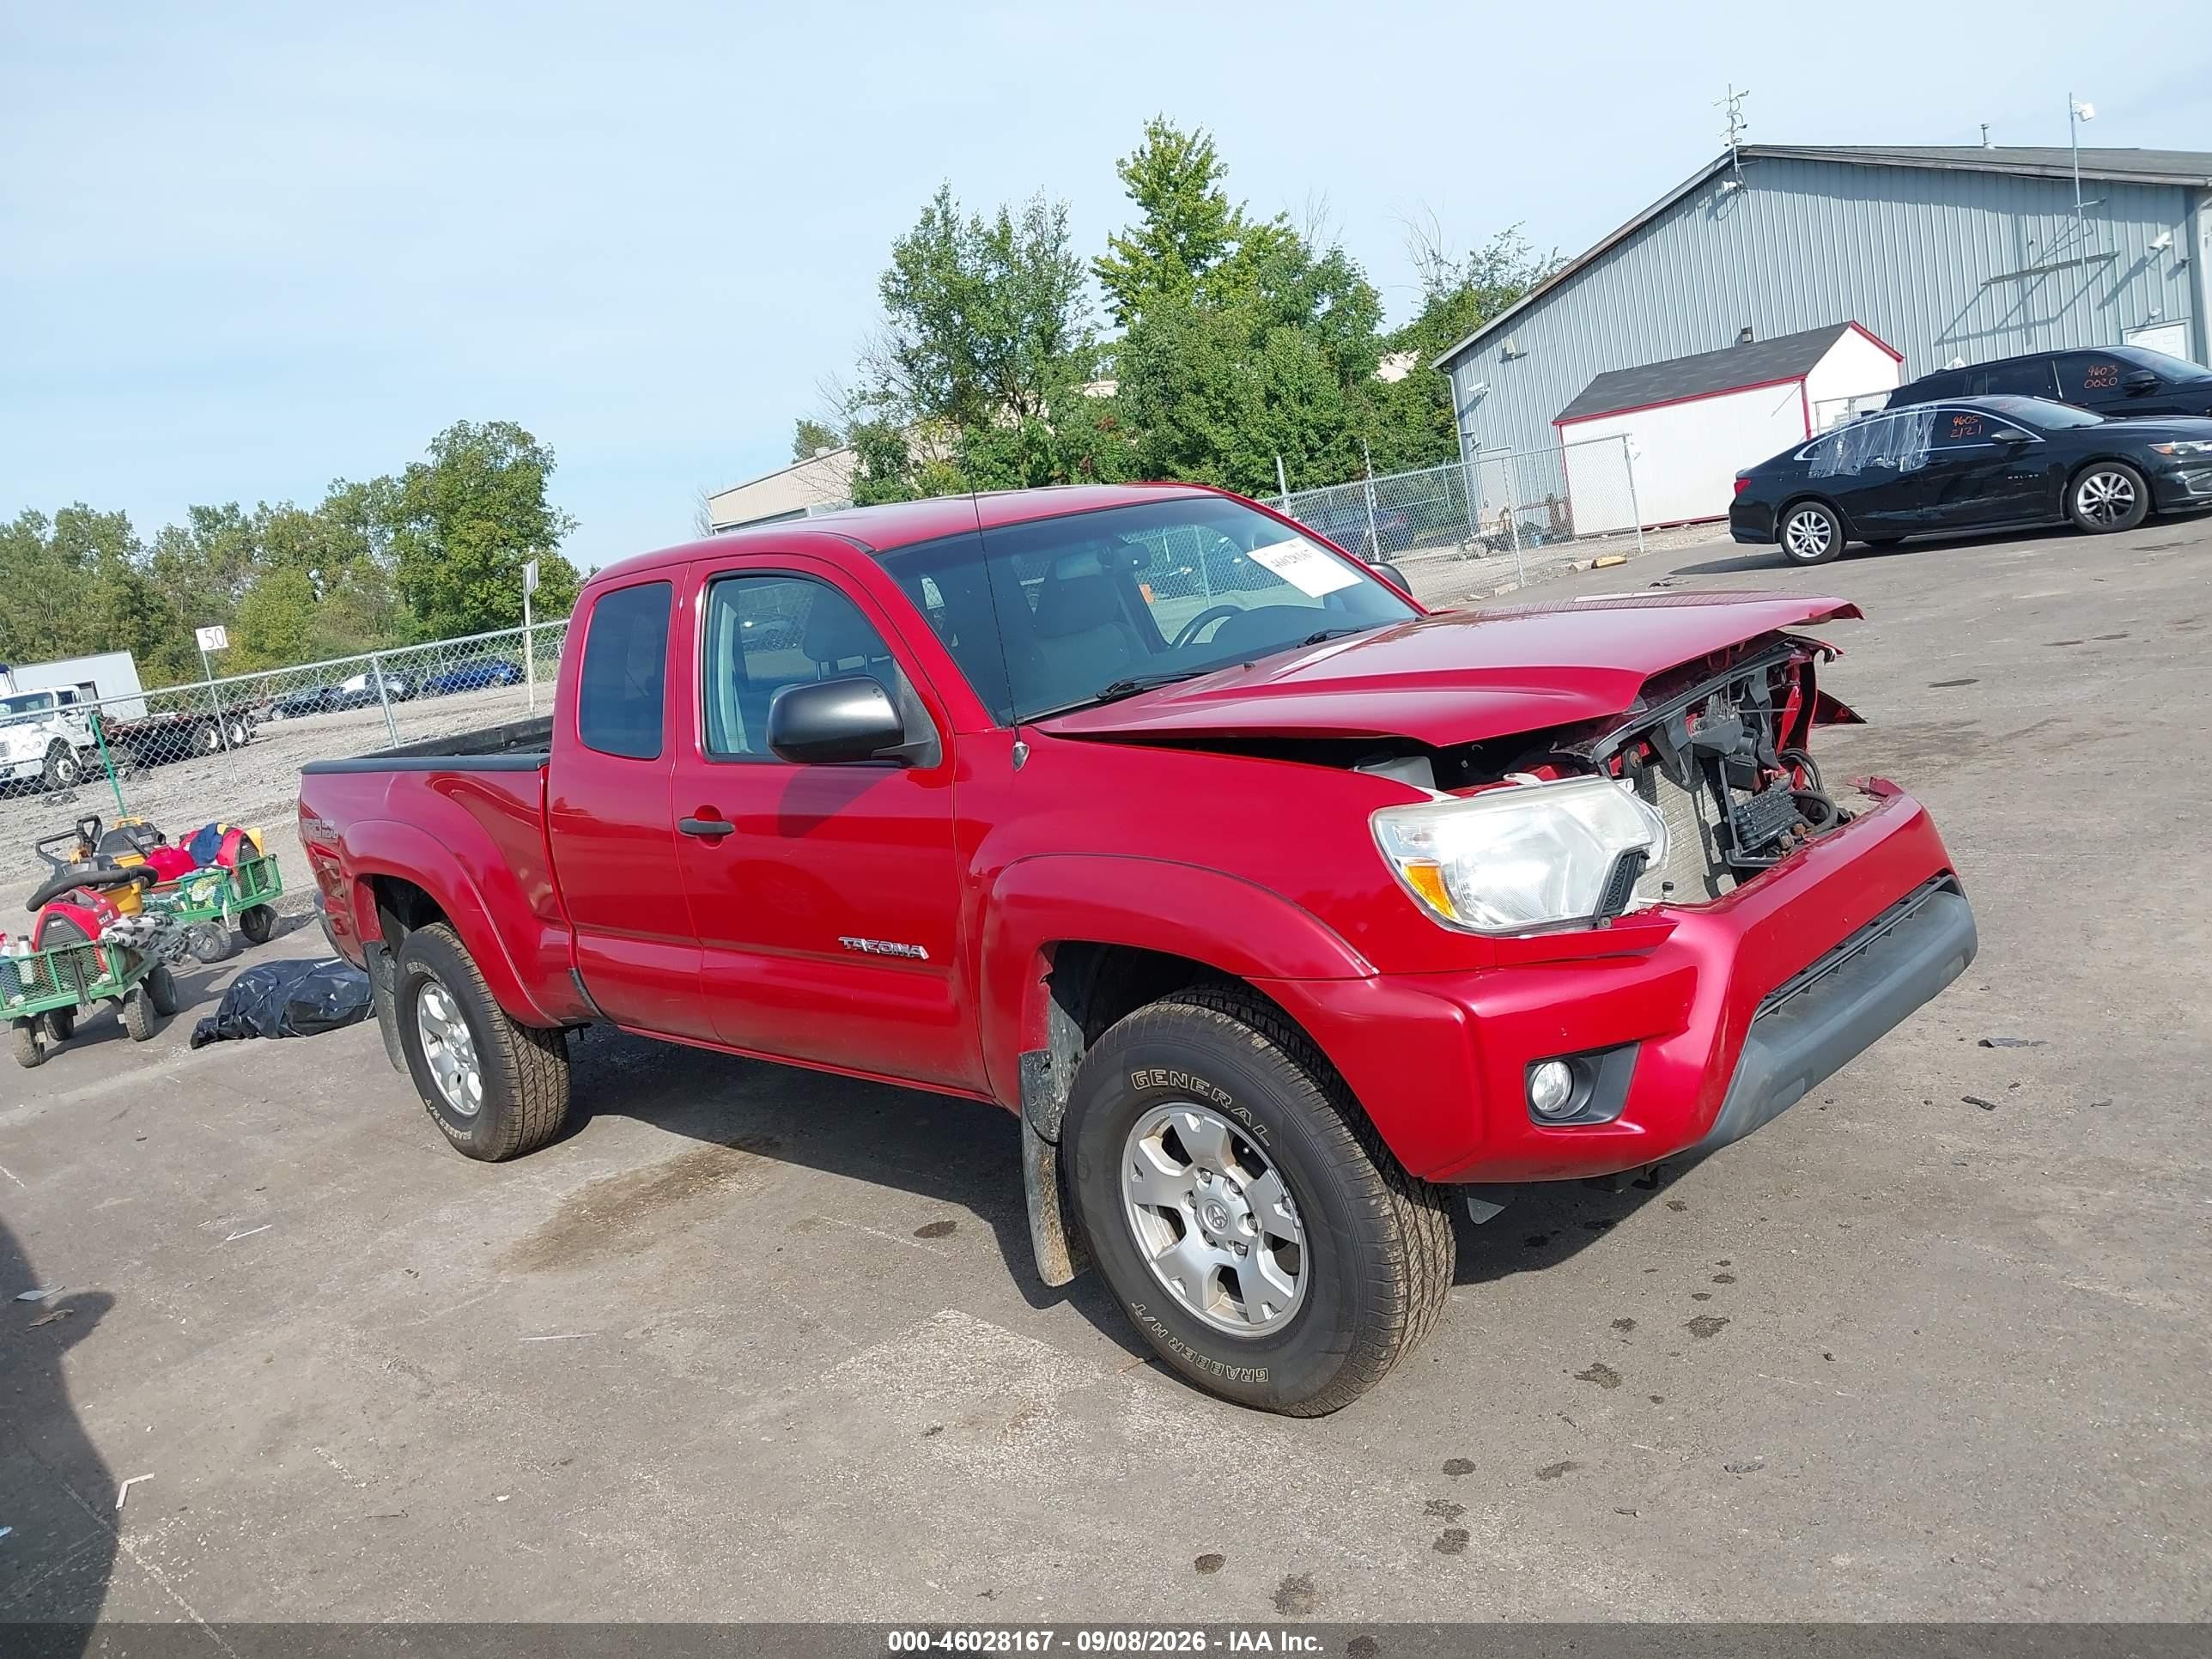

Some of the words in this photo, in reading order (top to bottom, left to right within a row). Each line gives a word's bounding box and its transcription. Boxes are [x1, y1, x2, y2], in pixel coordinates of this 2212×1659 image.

[2087, 364, 2118, 377] 4603
[2084, 377, 2118, 389] 0020
[1953, 415, 1983, 427] 4605
[204, 627, 225, 648] 50
[838, 936, 930, 960] TACOMA
[1131, 1068, 1271, 1147] GENERAL
[1131, 1302, 1169, 1339] H/T
[1168, 1336, 1269, 1382] GRABBER
